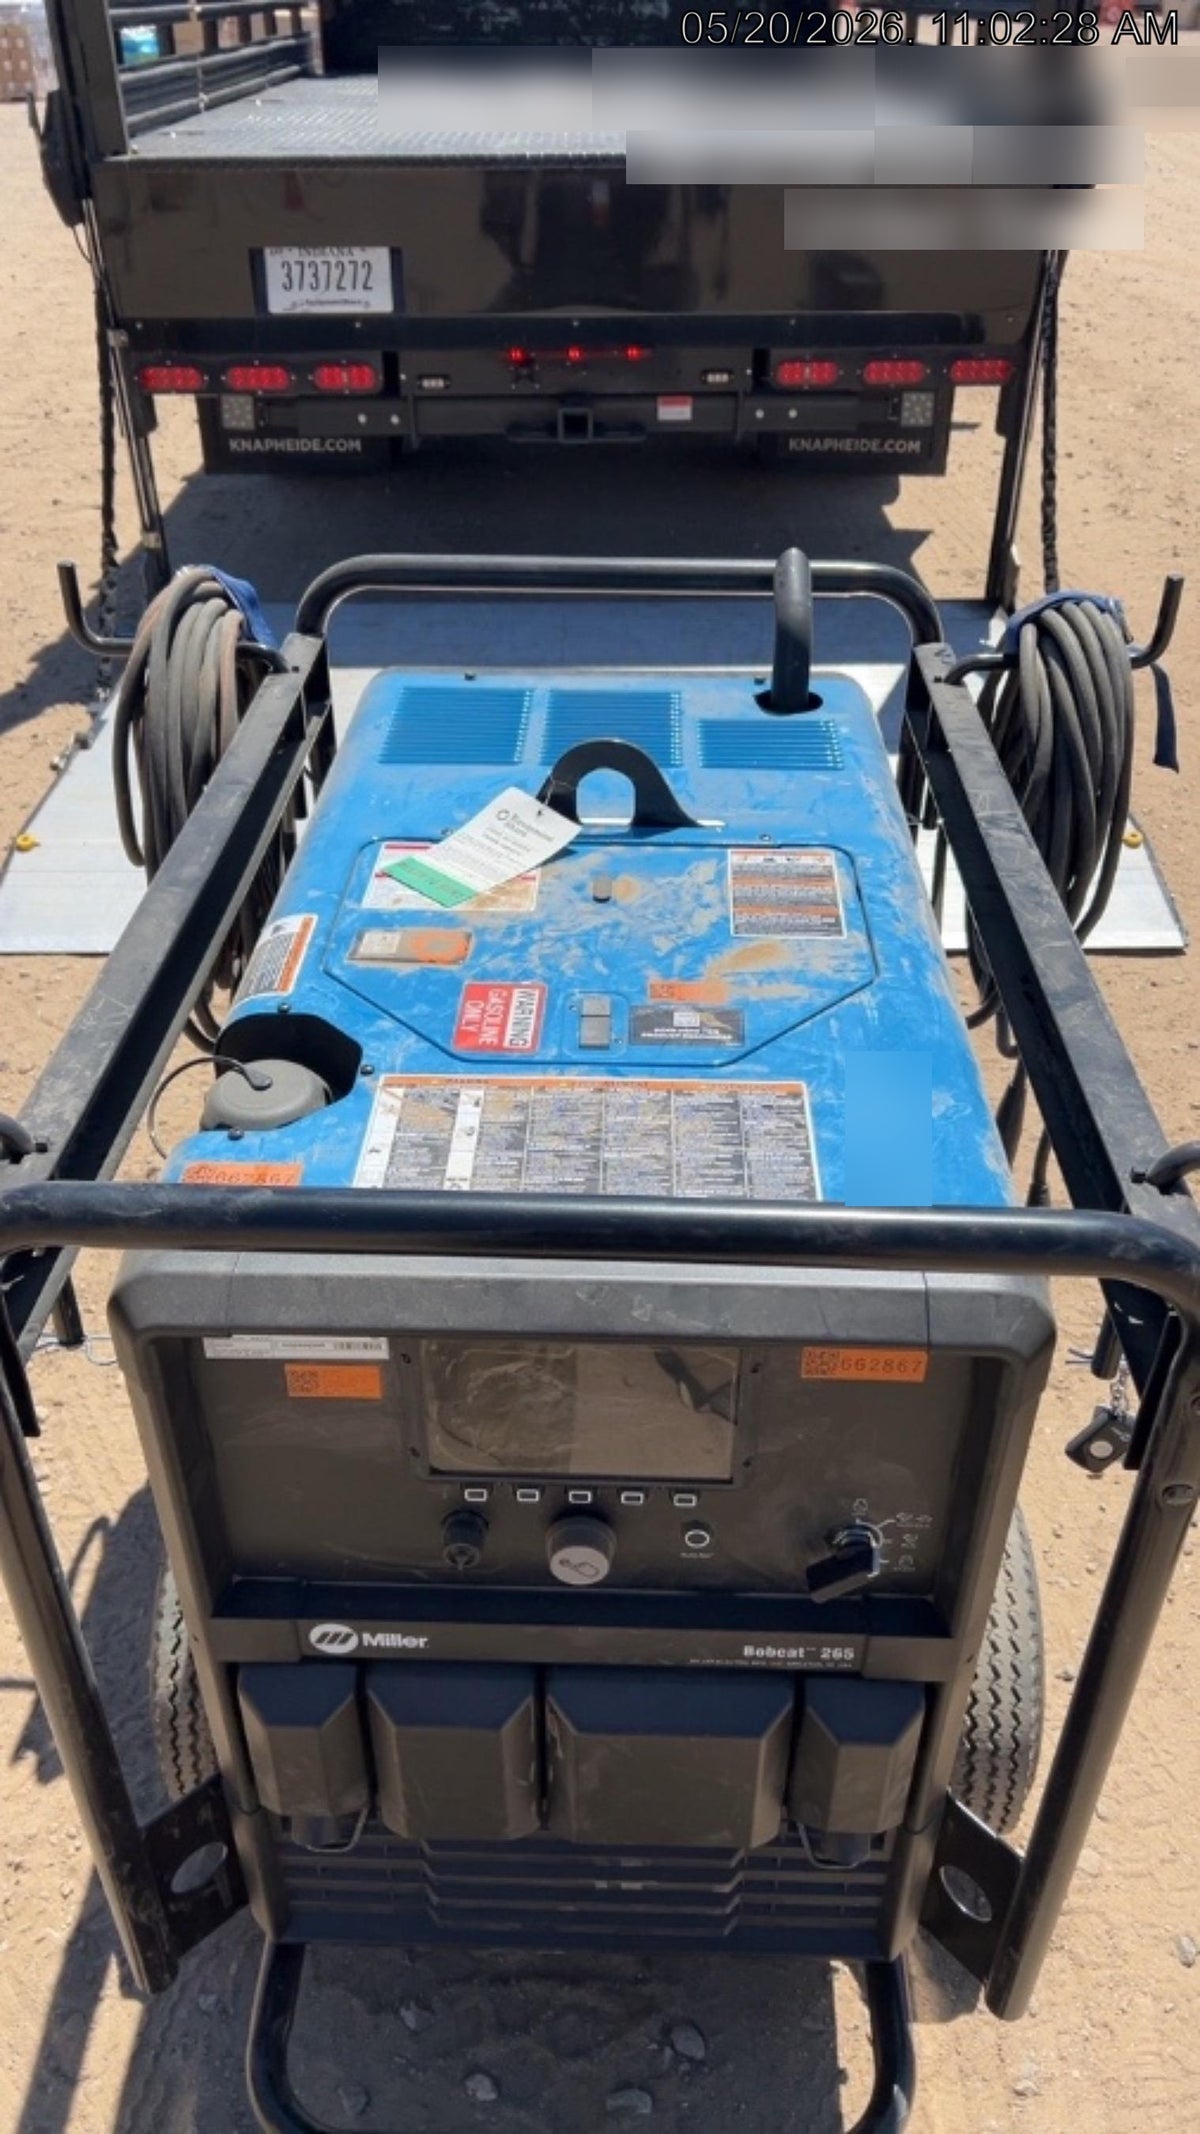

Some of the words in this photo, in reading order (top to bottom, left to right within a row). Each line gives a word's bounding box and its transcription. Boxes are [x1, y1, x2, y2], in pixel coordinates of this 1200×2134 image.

[281, 260, 374, 291] 3737272
[229, 438, 362, 452] KNAPHEIDE.COM
[788, 437, 922, 453] KNAPHEIDE.COM
[460, 1000, 485, 1033] ONLY
[479, 988, 508, 1046] GASOLINE
[509, 990, 536, 1046] WARNING
[841, 1357, 923, 1374] 662867
[362, 1632, 428, 1649] Miller
[743, 1644, 805, 1658] Bobcat
[820, 1647, 855, 1661] 265
